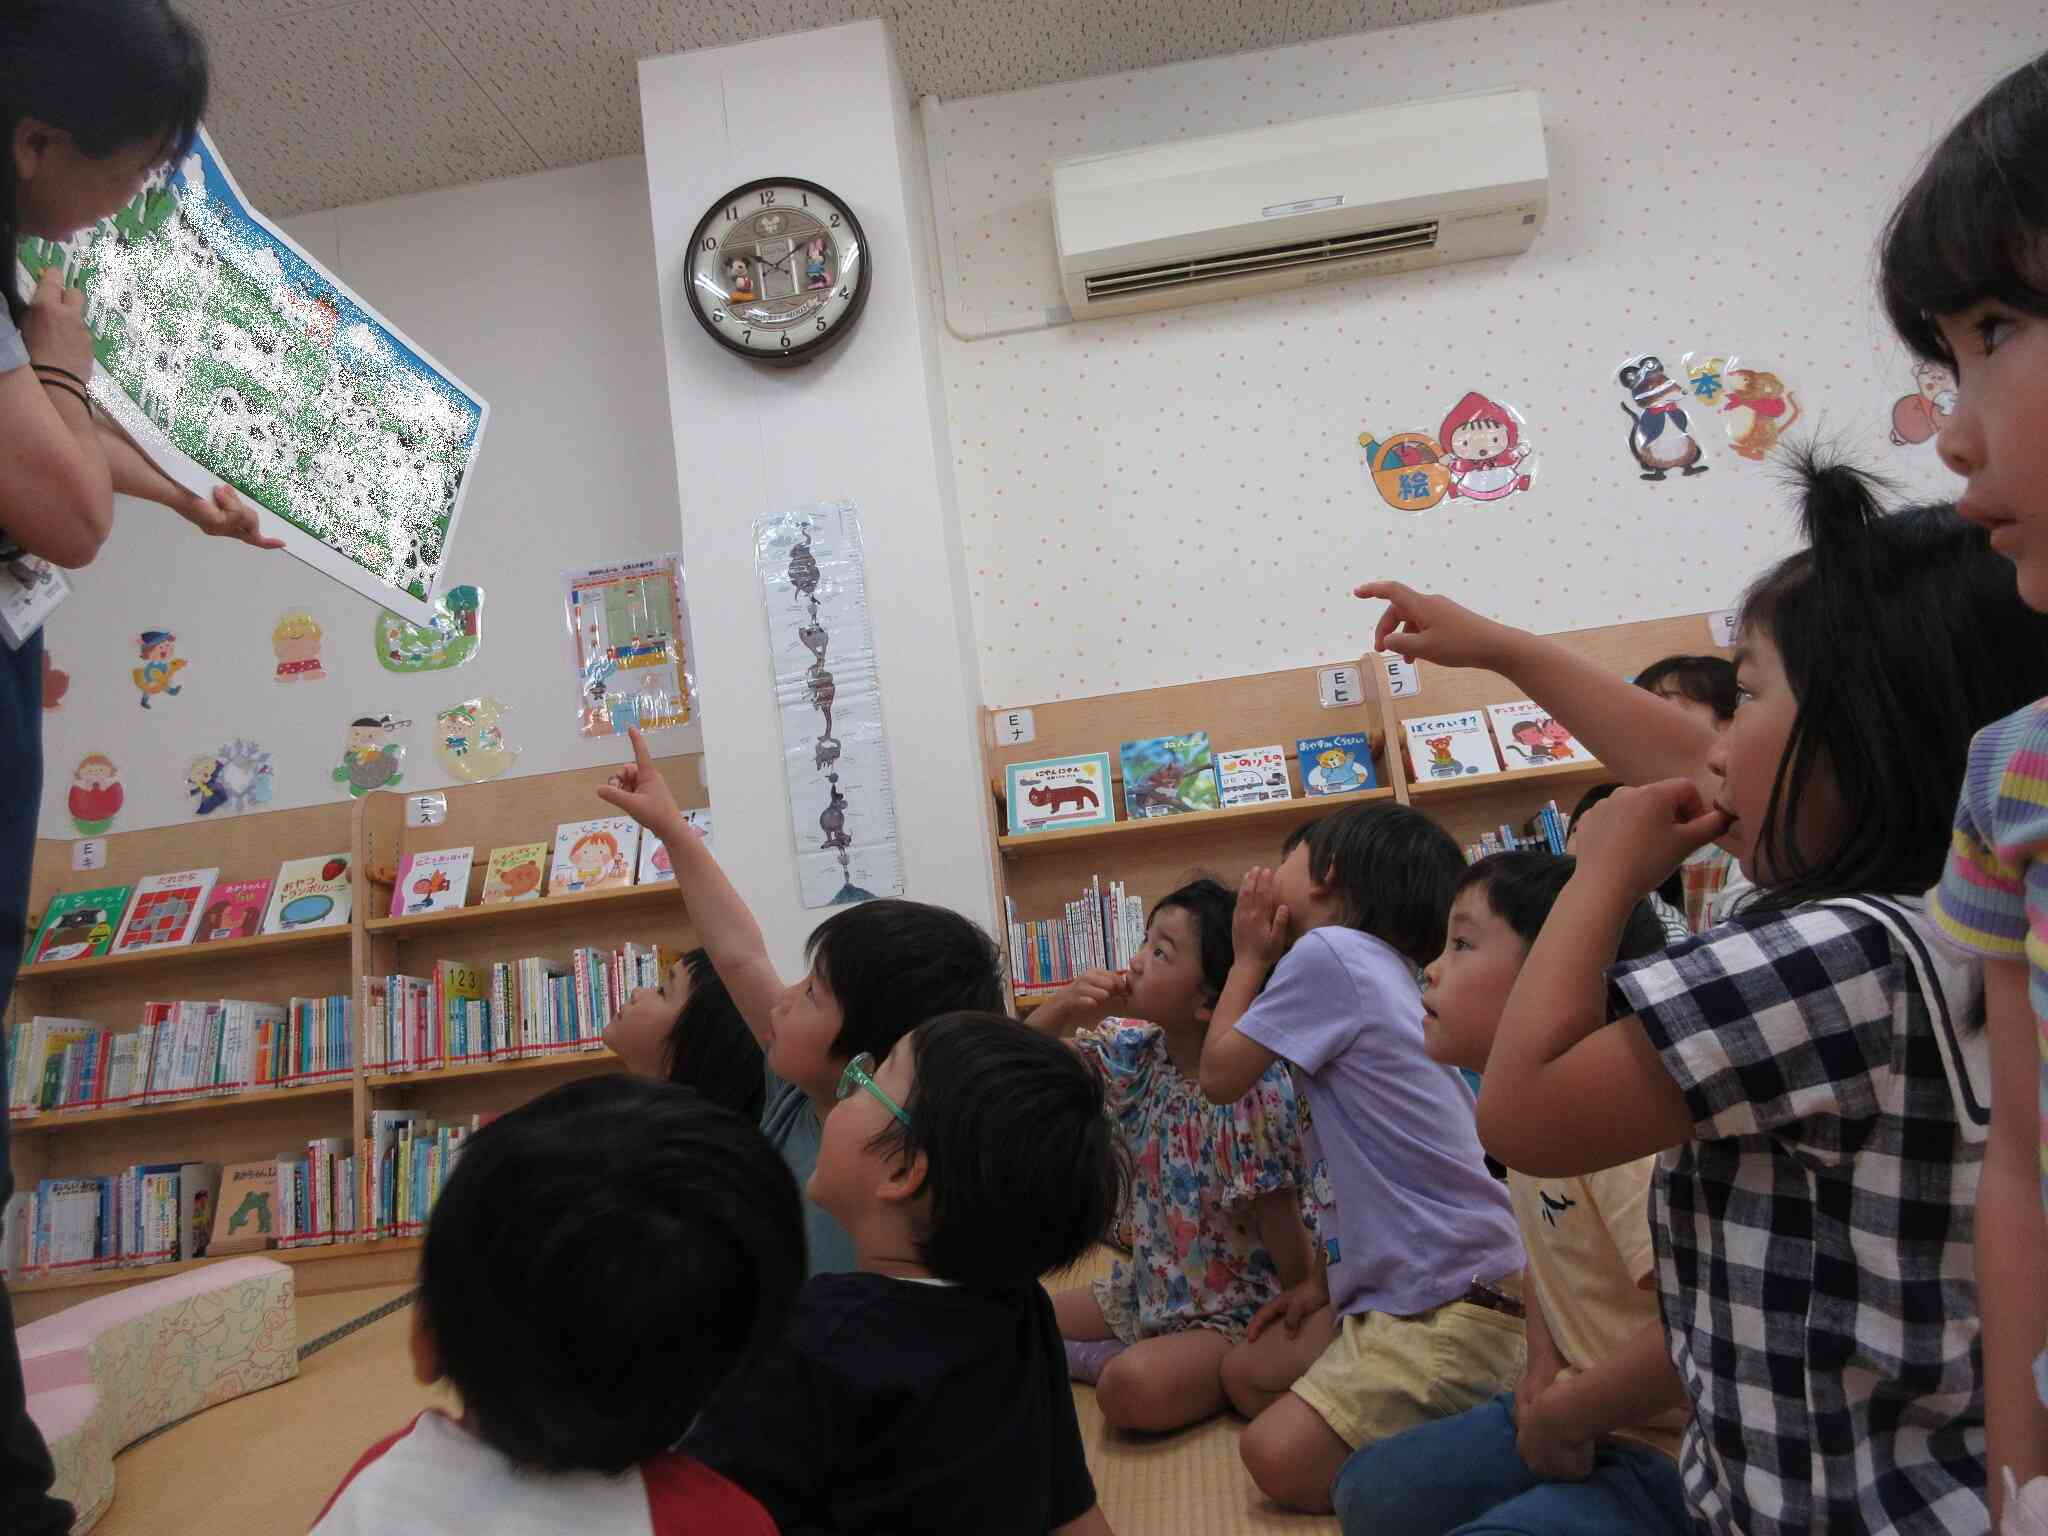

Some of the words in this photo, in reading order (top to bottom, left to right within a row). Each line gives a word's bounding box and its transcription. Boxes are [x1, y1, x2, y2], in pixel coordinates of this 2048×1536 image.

[760, 190, 775, 206] 12
[801, 193, 809, 206] 1
[725, 207, 739, 221] 11
[830, 214, 840, 228] 2
[702, 237, 717, 251] 10
[817, 317, 827, 331] 5
[742, 330, 752, 344] 7
[781, 331, 791, 346] 6
[1399, 472, 1430, 500] 絵
[1388, 664, 1400, 676] E
[1334, 672, 1347, 684] E
[1009, 715, 1019, 726] E
[1239, 754, 1282, 767] のりもの
